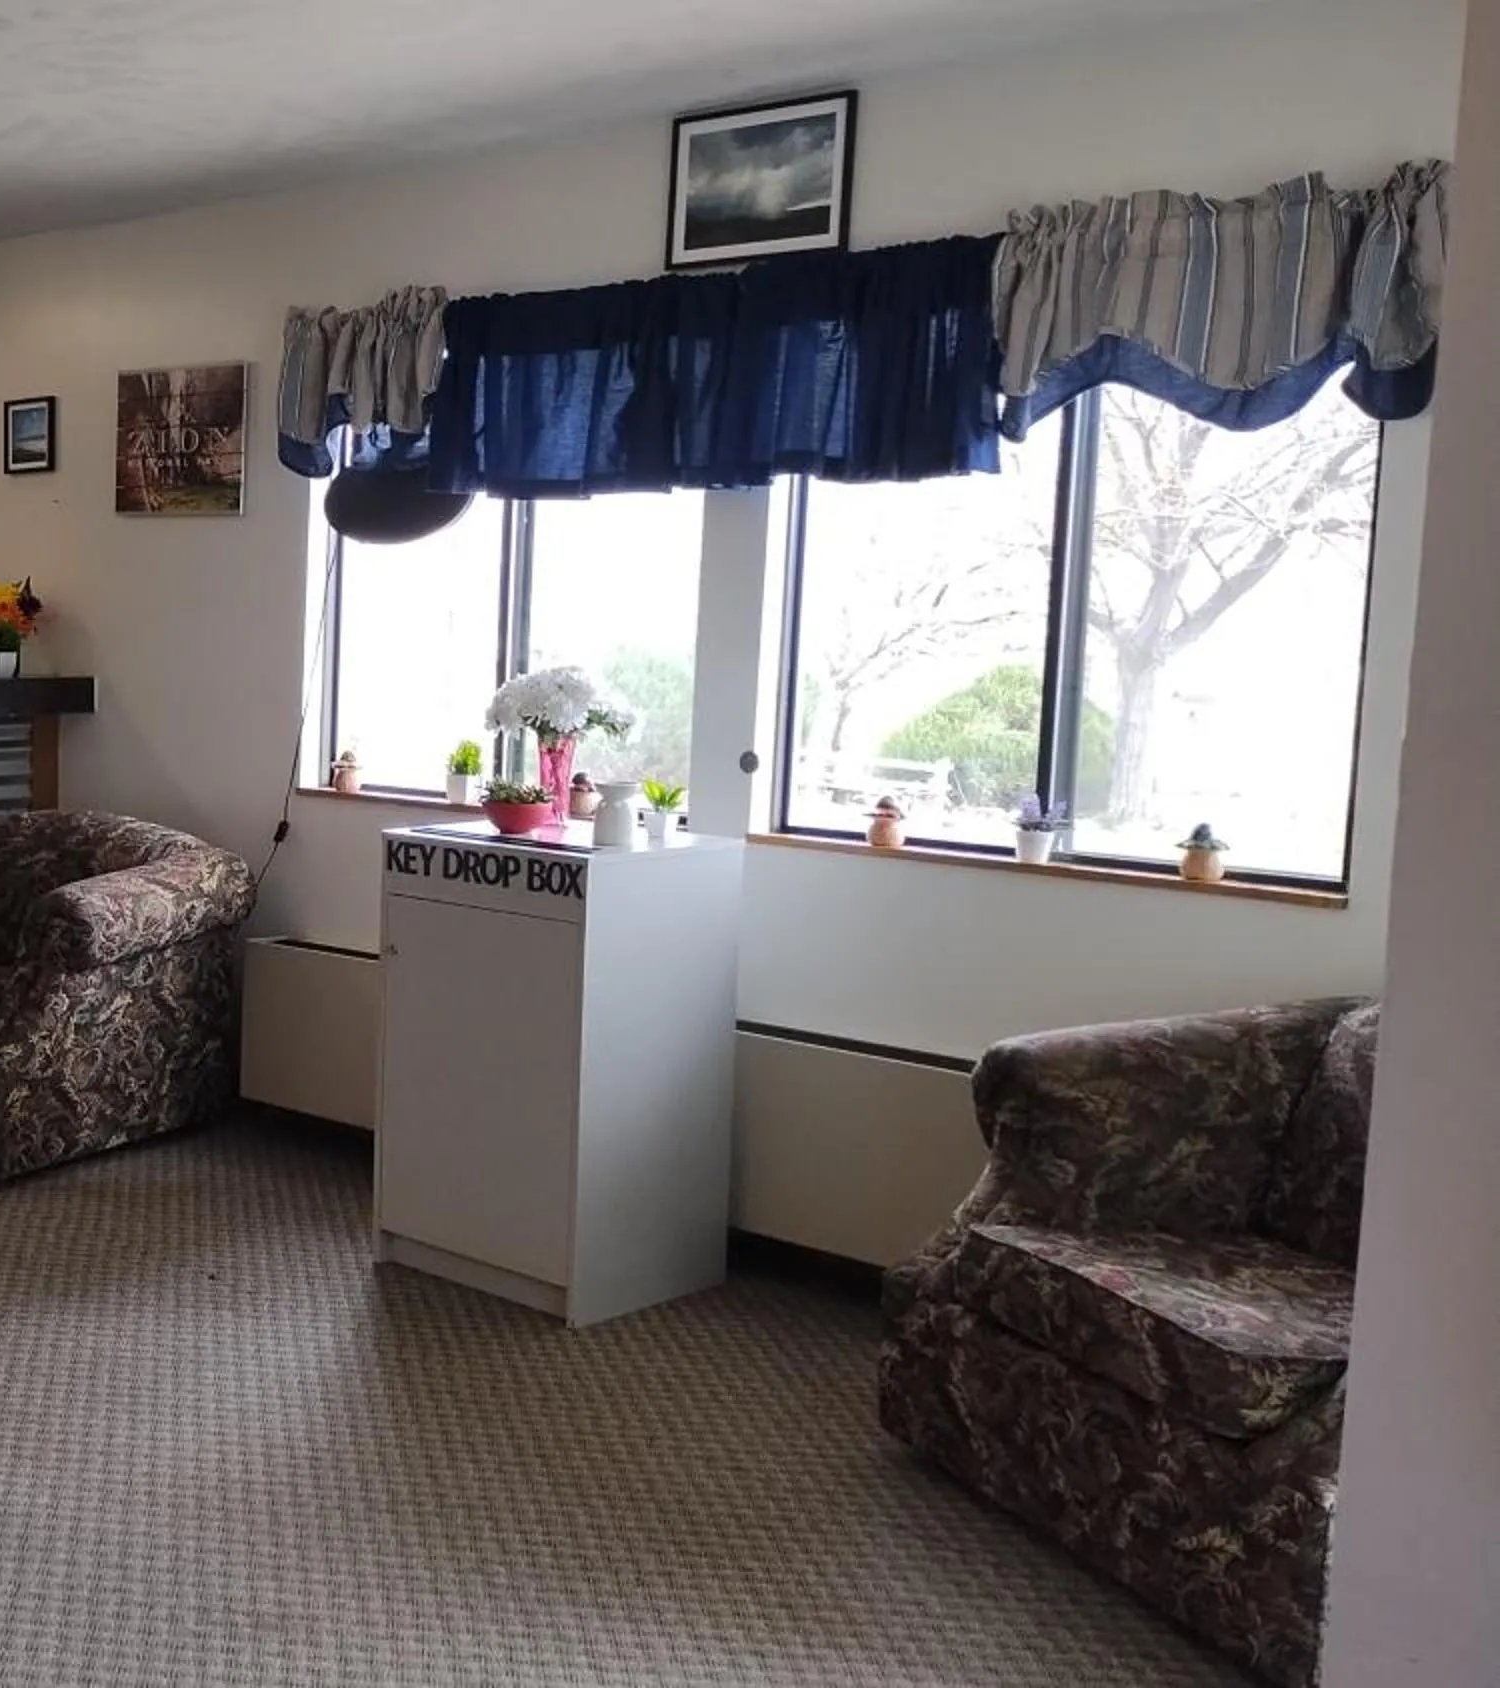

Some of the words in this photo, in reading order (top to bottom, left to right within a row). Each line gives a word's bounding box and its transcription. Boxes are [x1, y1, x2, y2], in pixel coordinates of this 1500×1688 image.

[387, 839, 436, 876] KEY
[442, 847, 521, 889] DROP
[527, 857, 583, 899] BOX
